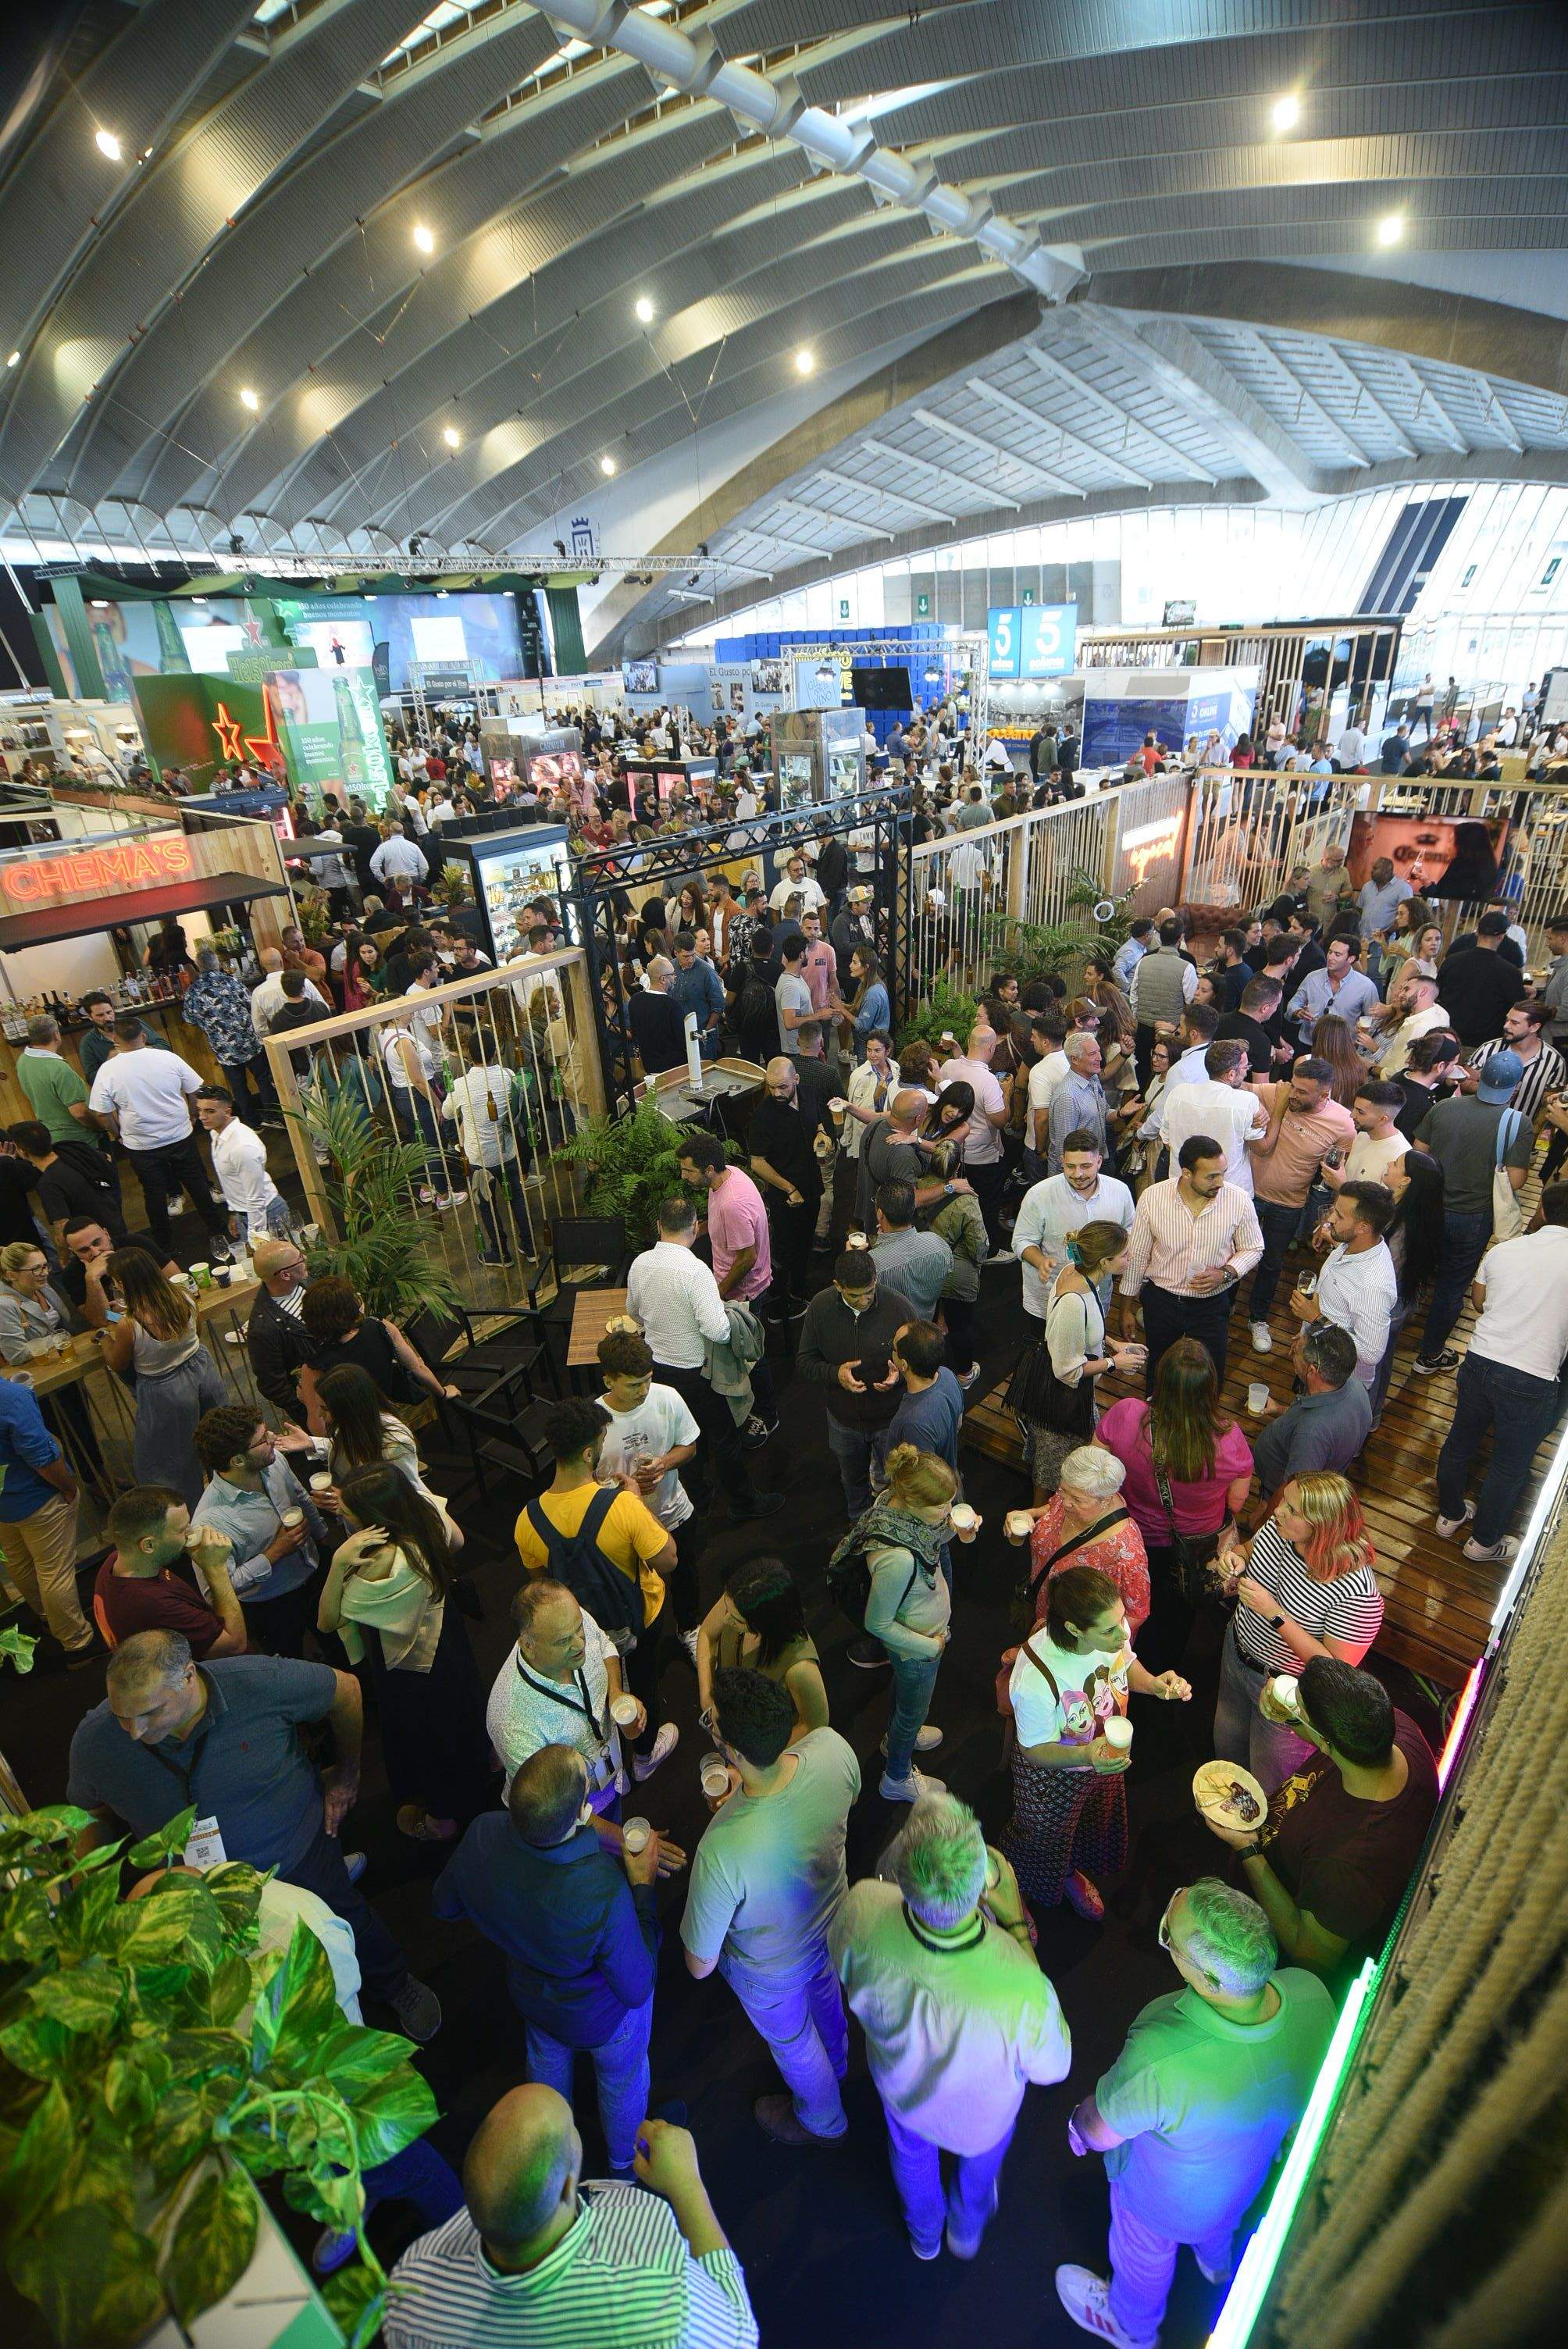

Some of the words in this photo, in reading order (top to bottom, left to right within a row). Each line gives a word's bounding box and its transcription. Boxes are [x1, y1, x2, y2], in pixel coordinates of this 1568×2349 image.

[995, 613, 1013, 656] 5
[1035, 611, 1063, 656] 5
[709, 667, 717, 676] El
[718, 667, 739, 676] Gusto
[431, 679, 444, 688] Gusto
[987, 724, 1040, 741] océano
[302, 742, 334, 750] celebrando
[2, 841, 191, 902] CHEMA'S
